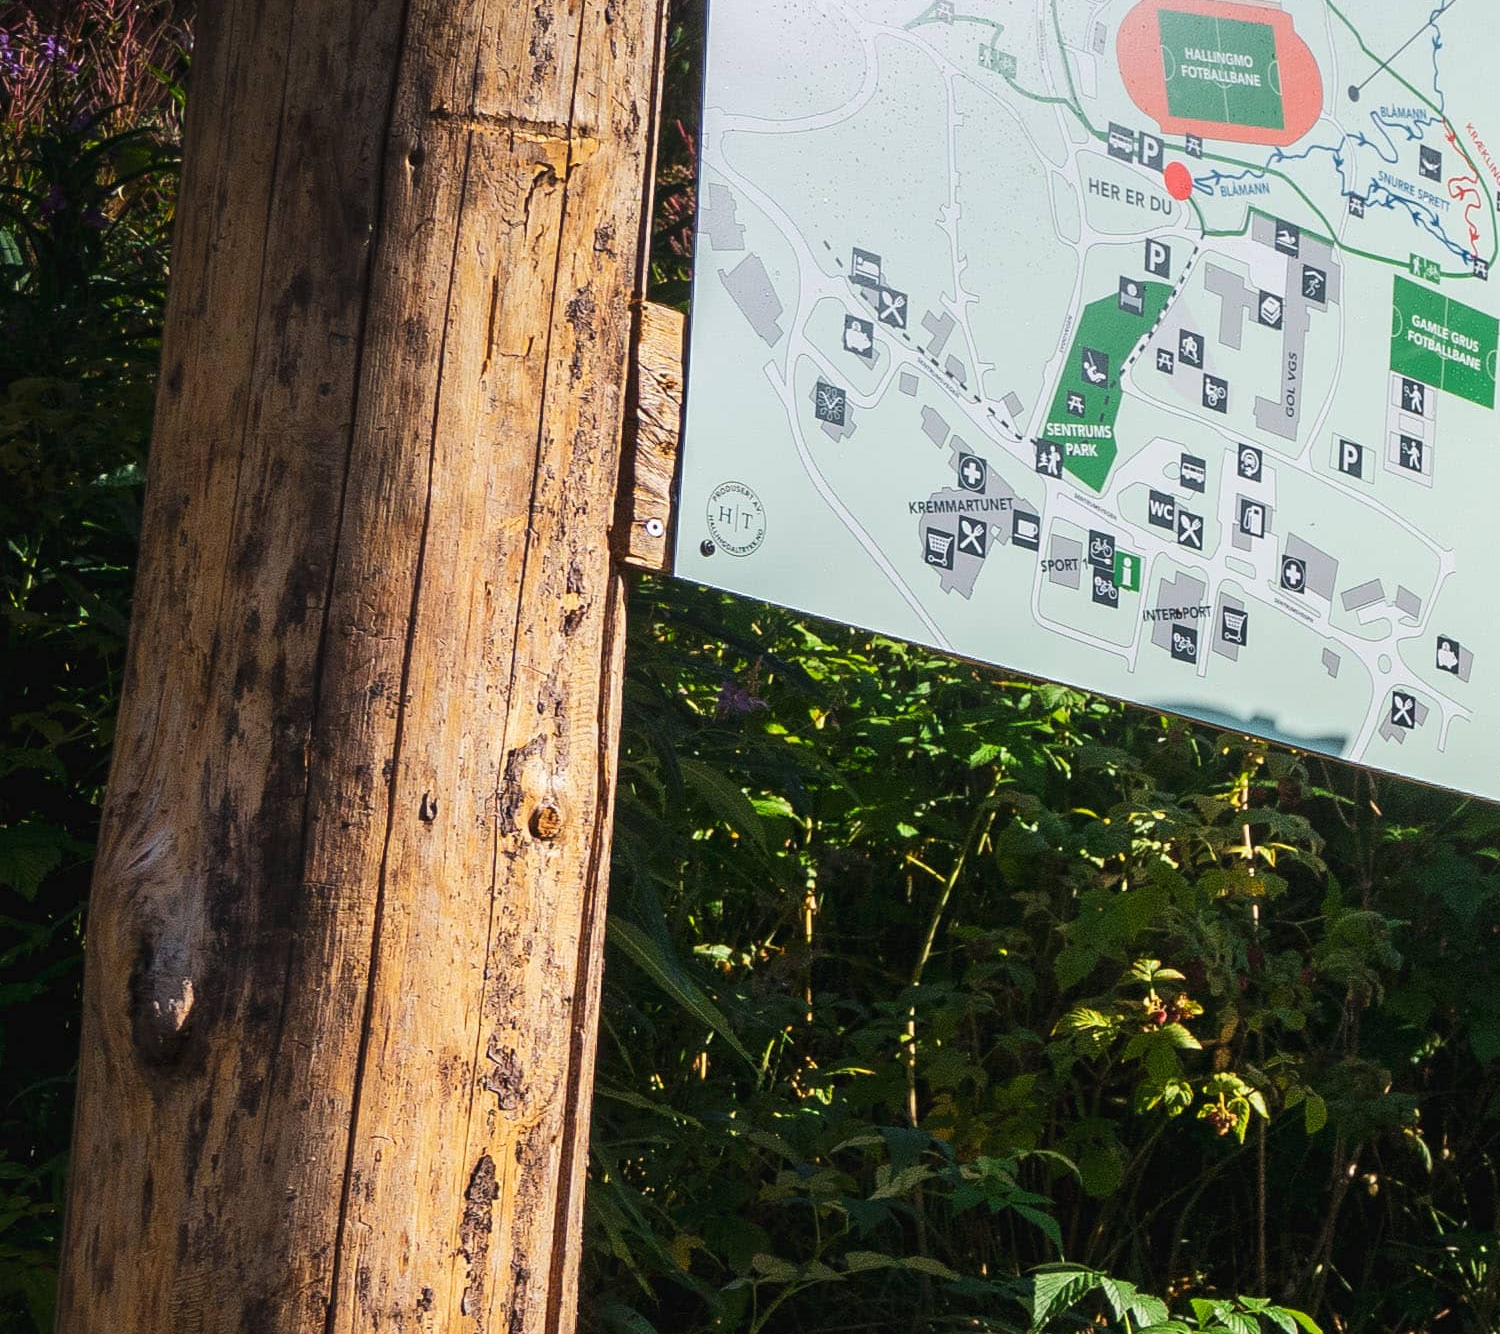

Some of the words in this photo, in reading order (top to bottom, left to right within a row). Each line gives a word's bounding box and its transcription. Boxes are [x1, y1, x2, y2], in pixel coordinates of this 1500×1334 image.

[1184, 47, 1253, 68] HALLINGMO
[1181, 65, 1261, 88] FOTBALLBANE
[1380, 103, 1427, 119] BLÅMANN
[1088, 177, 1115, 199] HER
[1125, 188, 1146, 206] ER
[1150, 196, 1173, 216] DU
[1220, 180, 1271, 198] BLÅMANN
[1378, 171, 1415, 196] SNURRE
[1418, 188, 1451, 212] SPRETT
[1411, 314, 1449, 340] GAMLE
[1451, 331, 1480, 353] GRUS
[1408, 330, 1481, 371] FOTBALLBANE
[1287, 352, 1298, 384] VGS
[1286, 387, 1295, 418] GOL
[1047, 422, 1113, 439] SENTRUMS
[1065, 443, 1098, 457] PARK
[908, 498, 1014, 515] KREMMARTUNET
[1150, 500, 1173, 521] WC
[1040, 559, 1079, 573] SPORT
